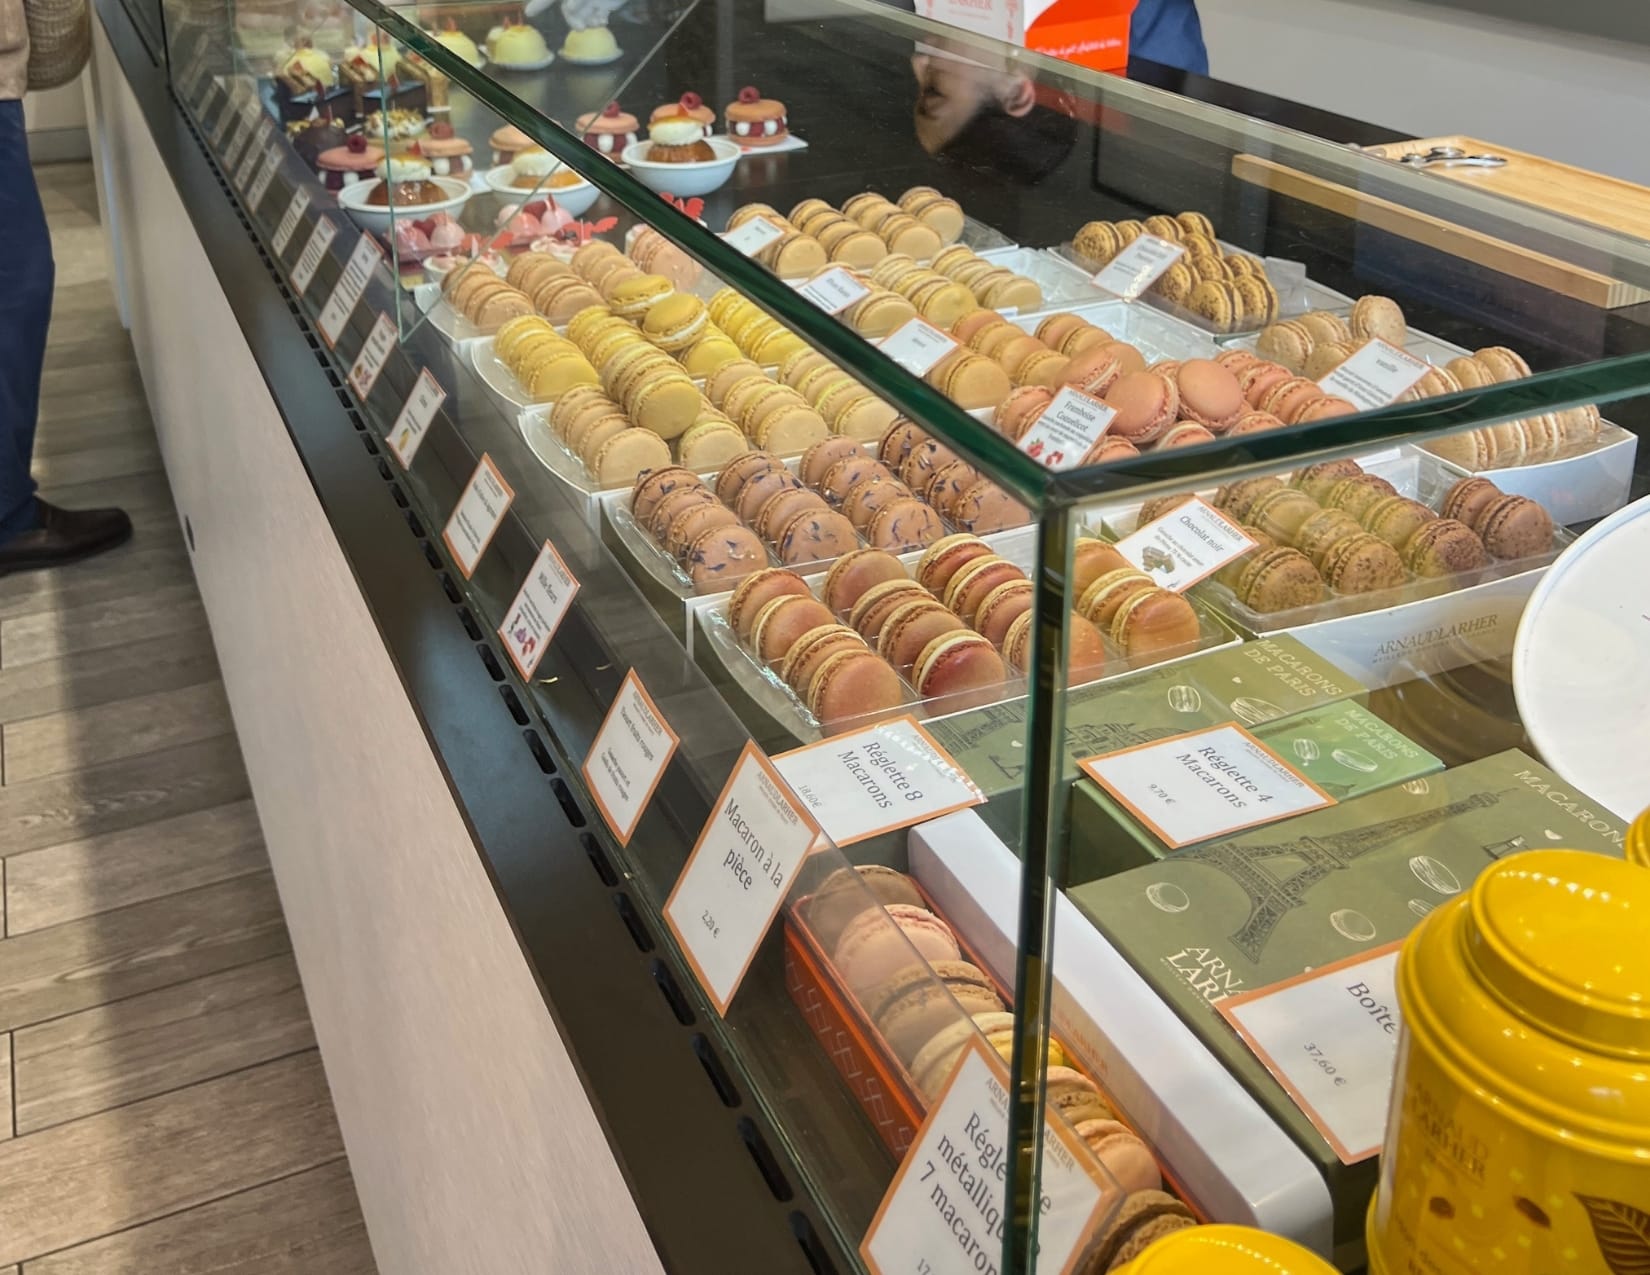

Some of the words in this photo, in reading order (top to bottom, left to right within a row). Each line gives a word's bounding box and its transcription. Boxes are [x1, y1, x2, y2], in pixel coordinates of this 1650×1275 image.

[1180, 515, 1210, 542] Chocolat
[1206, 538, 1225, 553] noir
[1243, 648, 1265, 665] DE
[1266, 662, 1318, 697] PARIS
[1257, 638, 1343, 697] MACARONS
[1333, 717, 1354, 732] DE
[1355, 731, 1399, 761] PARIS
[1344, 709, 1420, 760] MACARONS
[837, 750, 894, 810] Macarons
[863, 741, 910, 790] Réglette
[904, 790, 924, 802] 8
[1176, 752, 1248, 810] Macarons
[1198, 745, 1259, 794] Réglette
[1256, 793, 1275, 804] 4
[724, 796, 766, 864] Macaron
[763, 851, 774, 876] à
[770, 861, 784, 889] la
[723, 847, 754, 891] pièce
[713, 927, 721, 939] €
[1345, 981, 1397, 1034] Boîte
[1303, 1041, 1337, 1077] 37,60
[1334, 1073, 1347, 1088] €
[919, 1160, 936, 1183] 7
